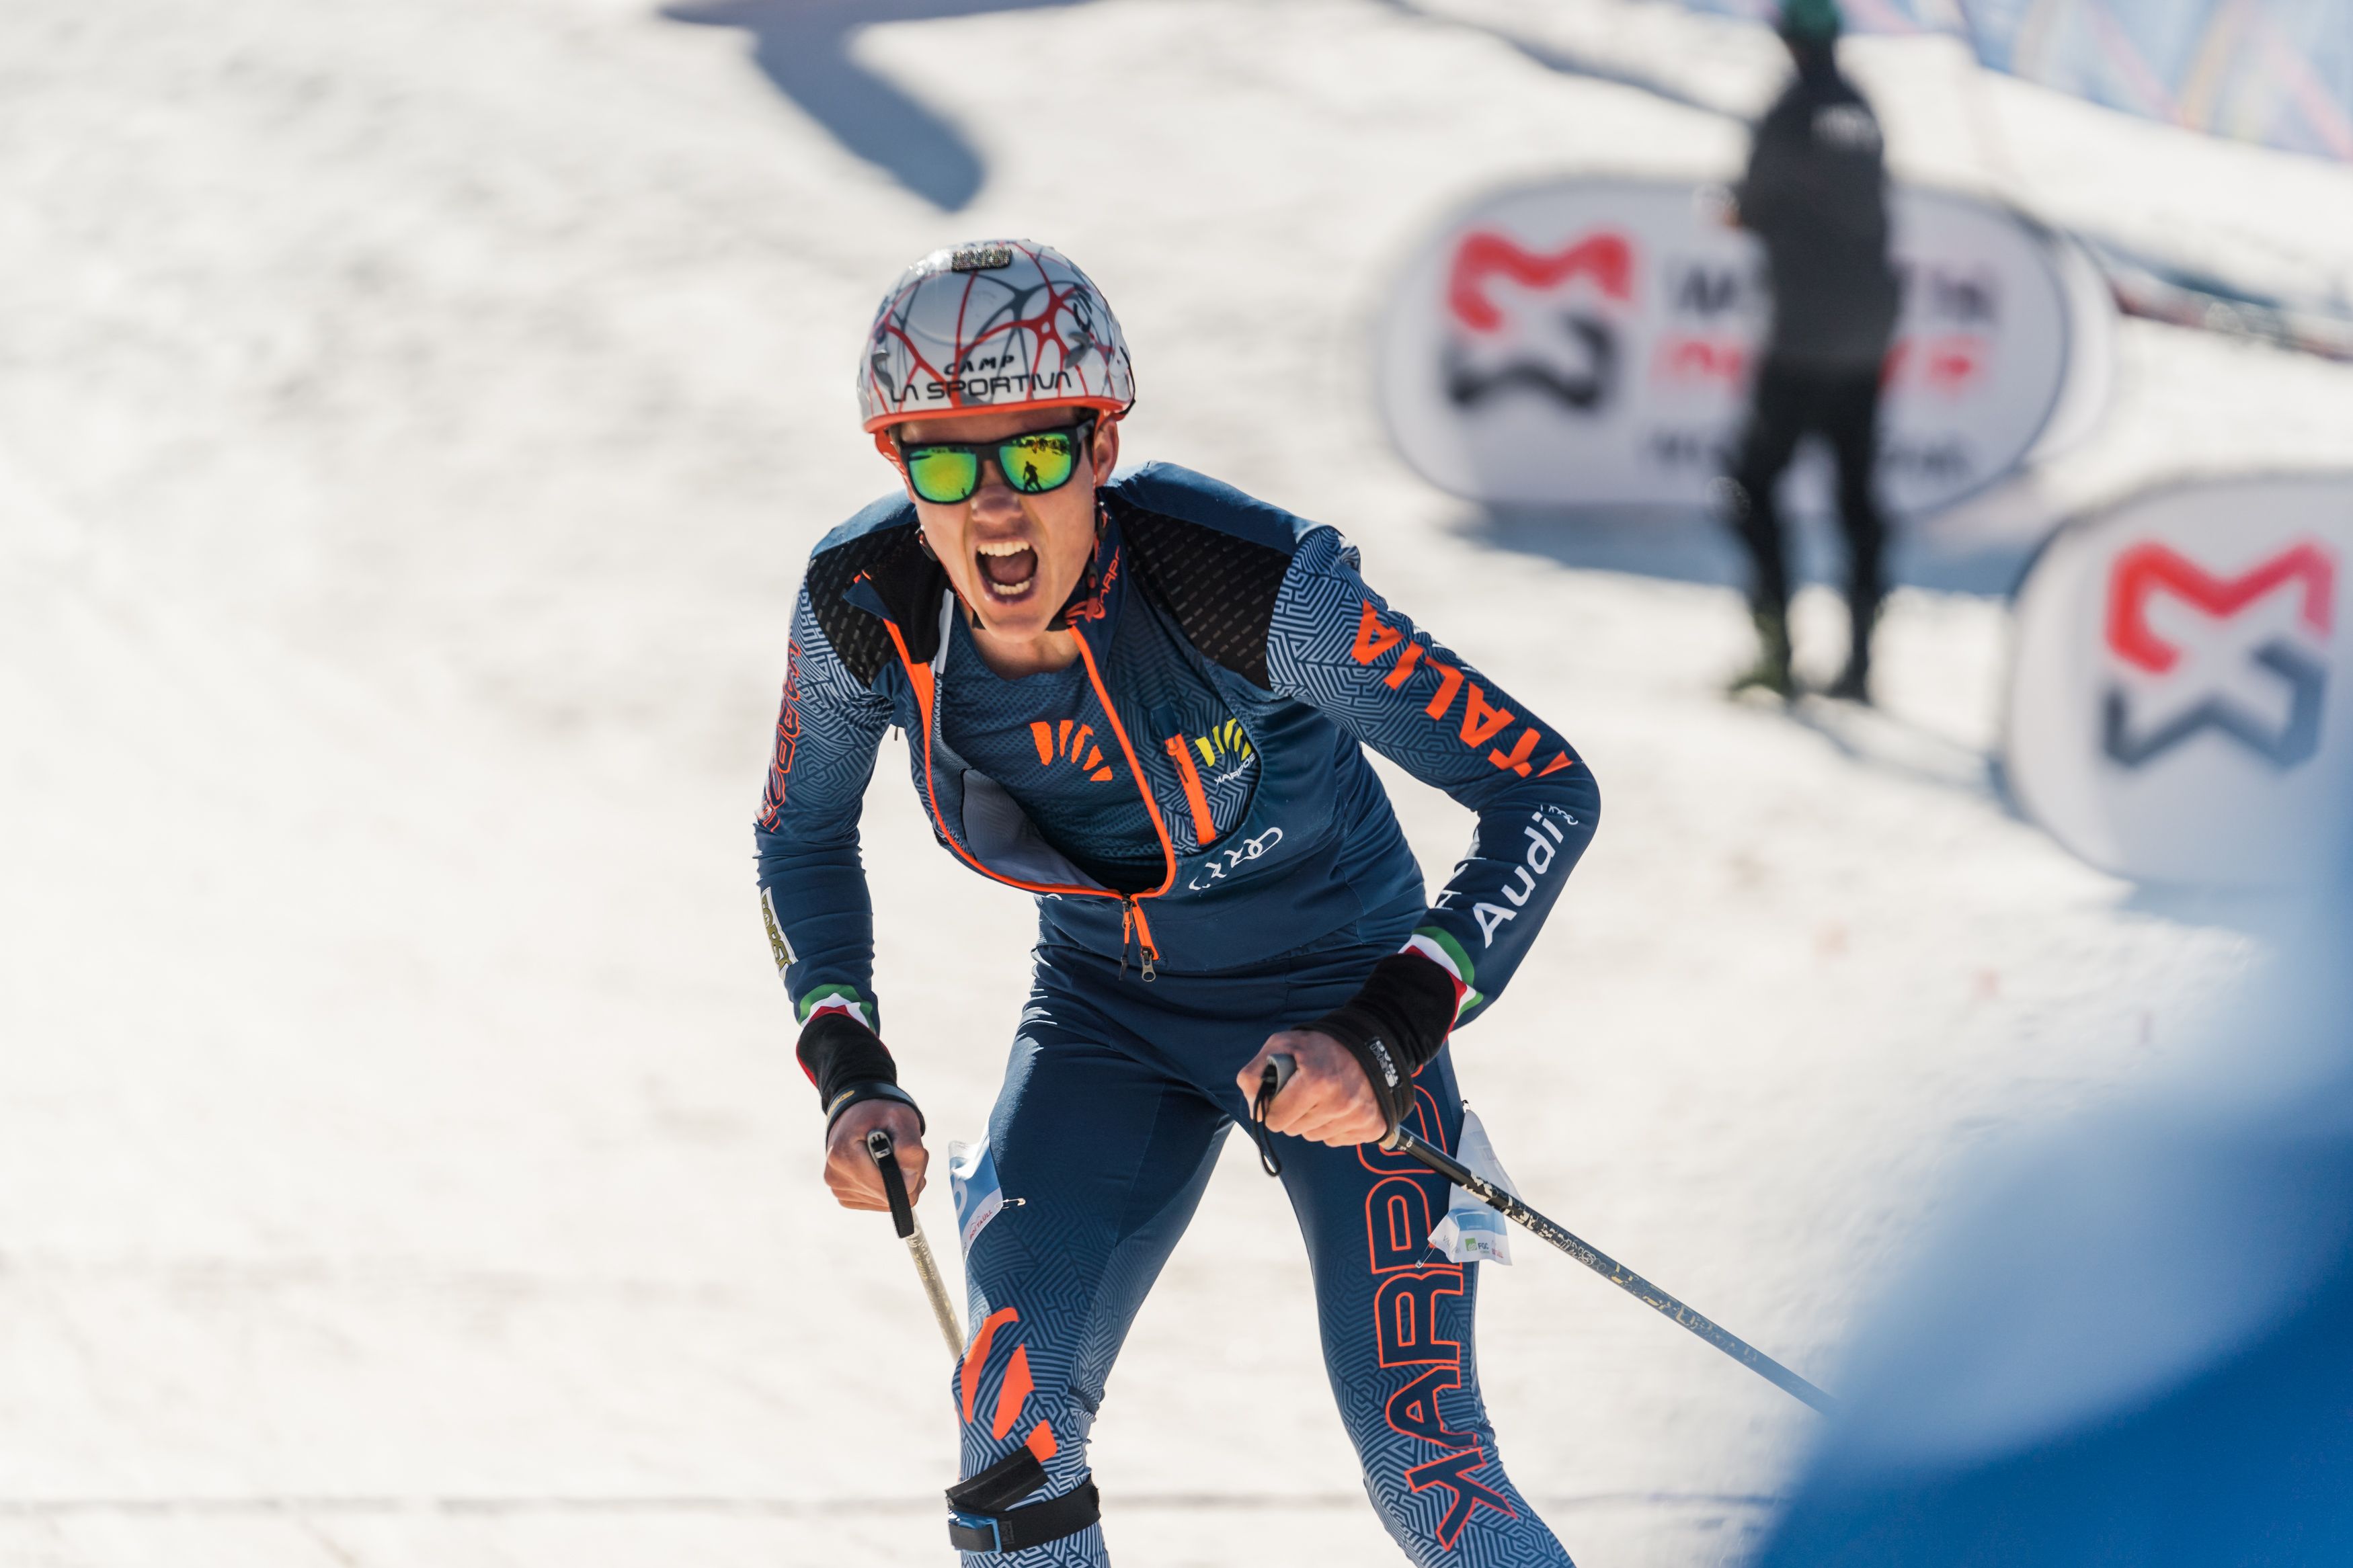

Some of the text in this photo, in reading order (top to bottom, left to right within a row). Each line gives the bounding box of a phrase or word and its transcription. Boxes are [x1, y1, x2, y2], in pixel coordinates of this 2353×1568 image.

[943, 355, 1015, 376] CAMP
[890, 371, 1072, 402] LA SPORTIVA
[1473, 811, 1564, 949] Audi
